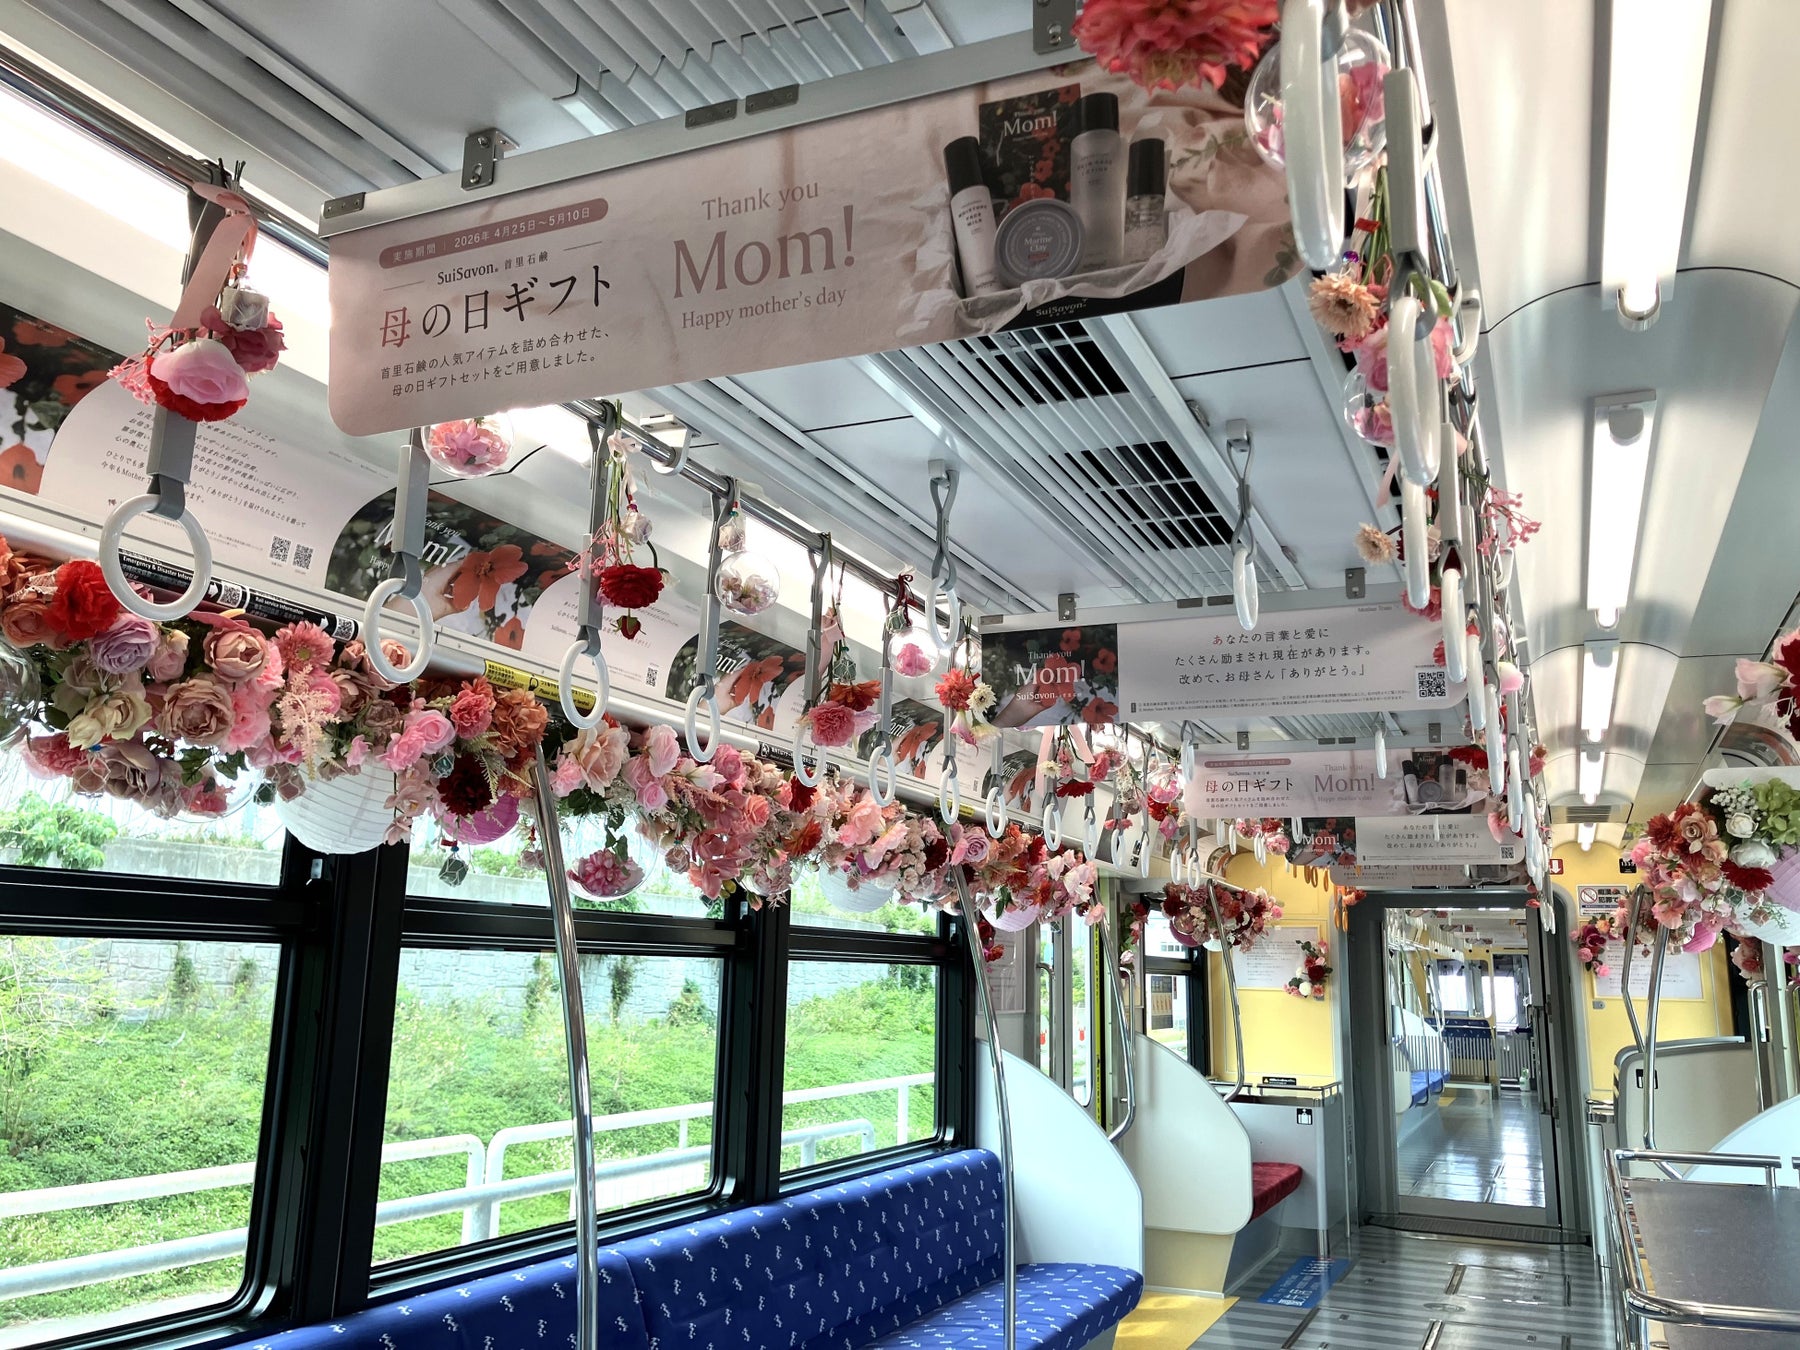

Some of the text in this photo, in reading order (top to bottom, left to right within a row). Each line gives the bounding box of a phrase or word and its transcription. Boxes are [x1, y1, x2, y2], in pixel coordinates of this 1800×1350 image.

[1003, 110, 1057, 136] Mom!
[701, 182, 818, 221] Thank you
[454, 231, 490, 248] 2026年
[673, 204, 855, 299] Mom!
[380, 265, 610, 348] 母の日ギフト
[682, 308, 734, 330] Happy
[816, 286, 847, 307] day
[381, 326, 609, 380] 首里石鹸の人気アイテムを詰め合わせた、
[392, 350, 597, 397] 母の日ギフトセットをご用意しました。
[123, 555, 152, 571] Emergency
[157, 565, 177, 577] Disaster
[1213, 628, 1329, 646] あなたの言葉と愛に
[1028, 650, 1072, 660] Thank you
[1175, 645, 1371, 667] たくさん励まされ現在があります。
[1016, 660, 1086, 686] Mom!
[1178, 664, 1366, 685] 改めて、お母さん「ありがとう。」
[1205, 778, 1294, 794] 母の日ギフト
[1314, 773, 1375, 793] Mom!
